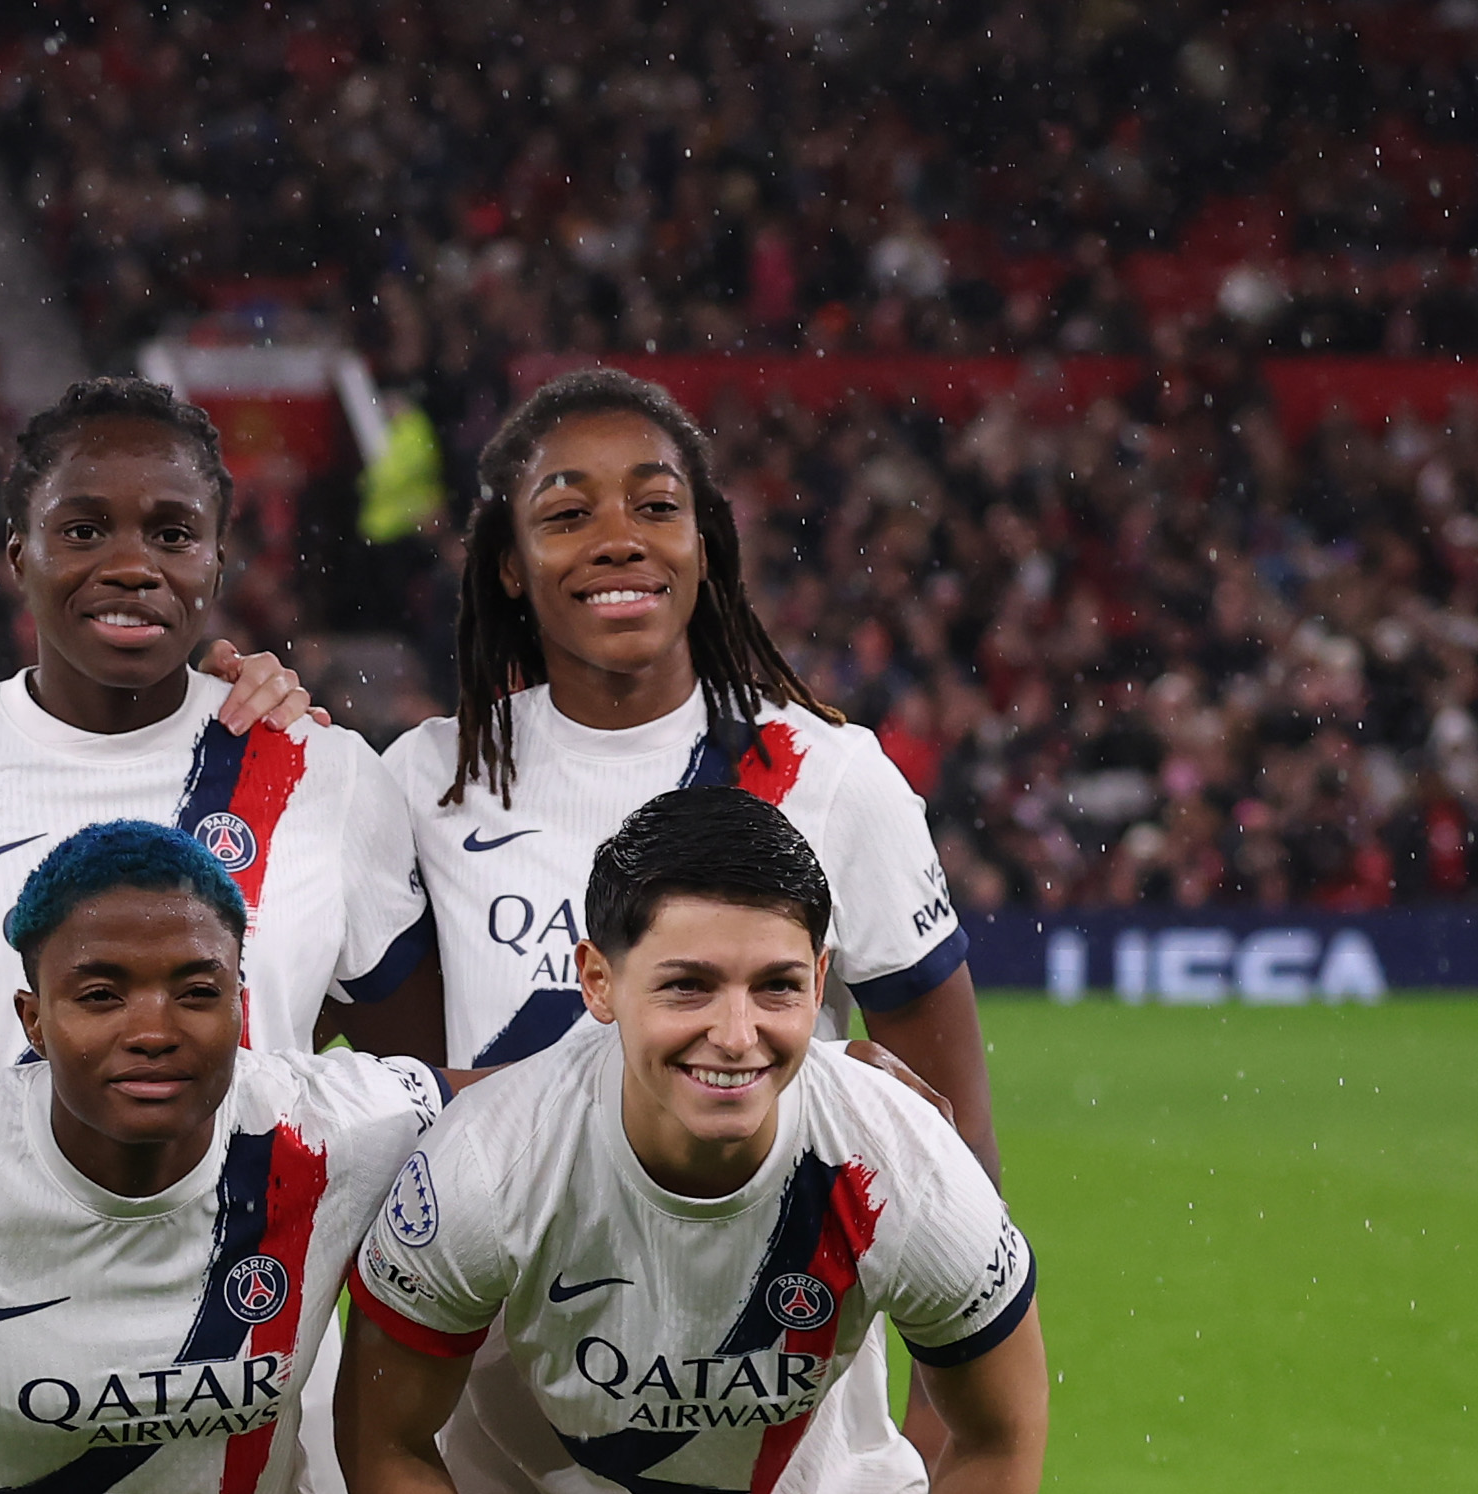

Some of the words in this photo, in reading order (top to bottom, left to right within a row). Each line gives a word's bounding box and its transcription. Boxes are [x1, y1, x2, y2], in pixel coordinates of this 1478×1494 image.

[203, 816, 245, 833] PARIS
[232, 1259, 275, 1280] PARIS
[388, 1264, 417, 1294] 10
[778, 1277, 821, 1292] PARIS
[575, 1336, 817, 1400] QATAR
[18, 1355, 281, 1432] QATAR
[88, 1402, 279, 1444] AIRWAYS
[629, 1394, 815, 1428] AIRWAYS
